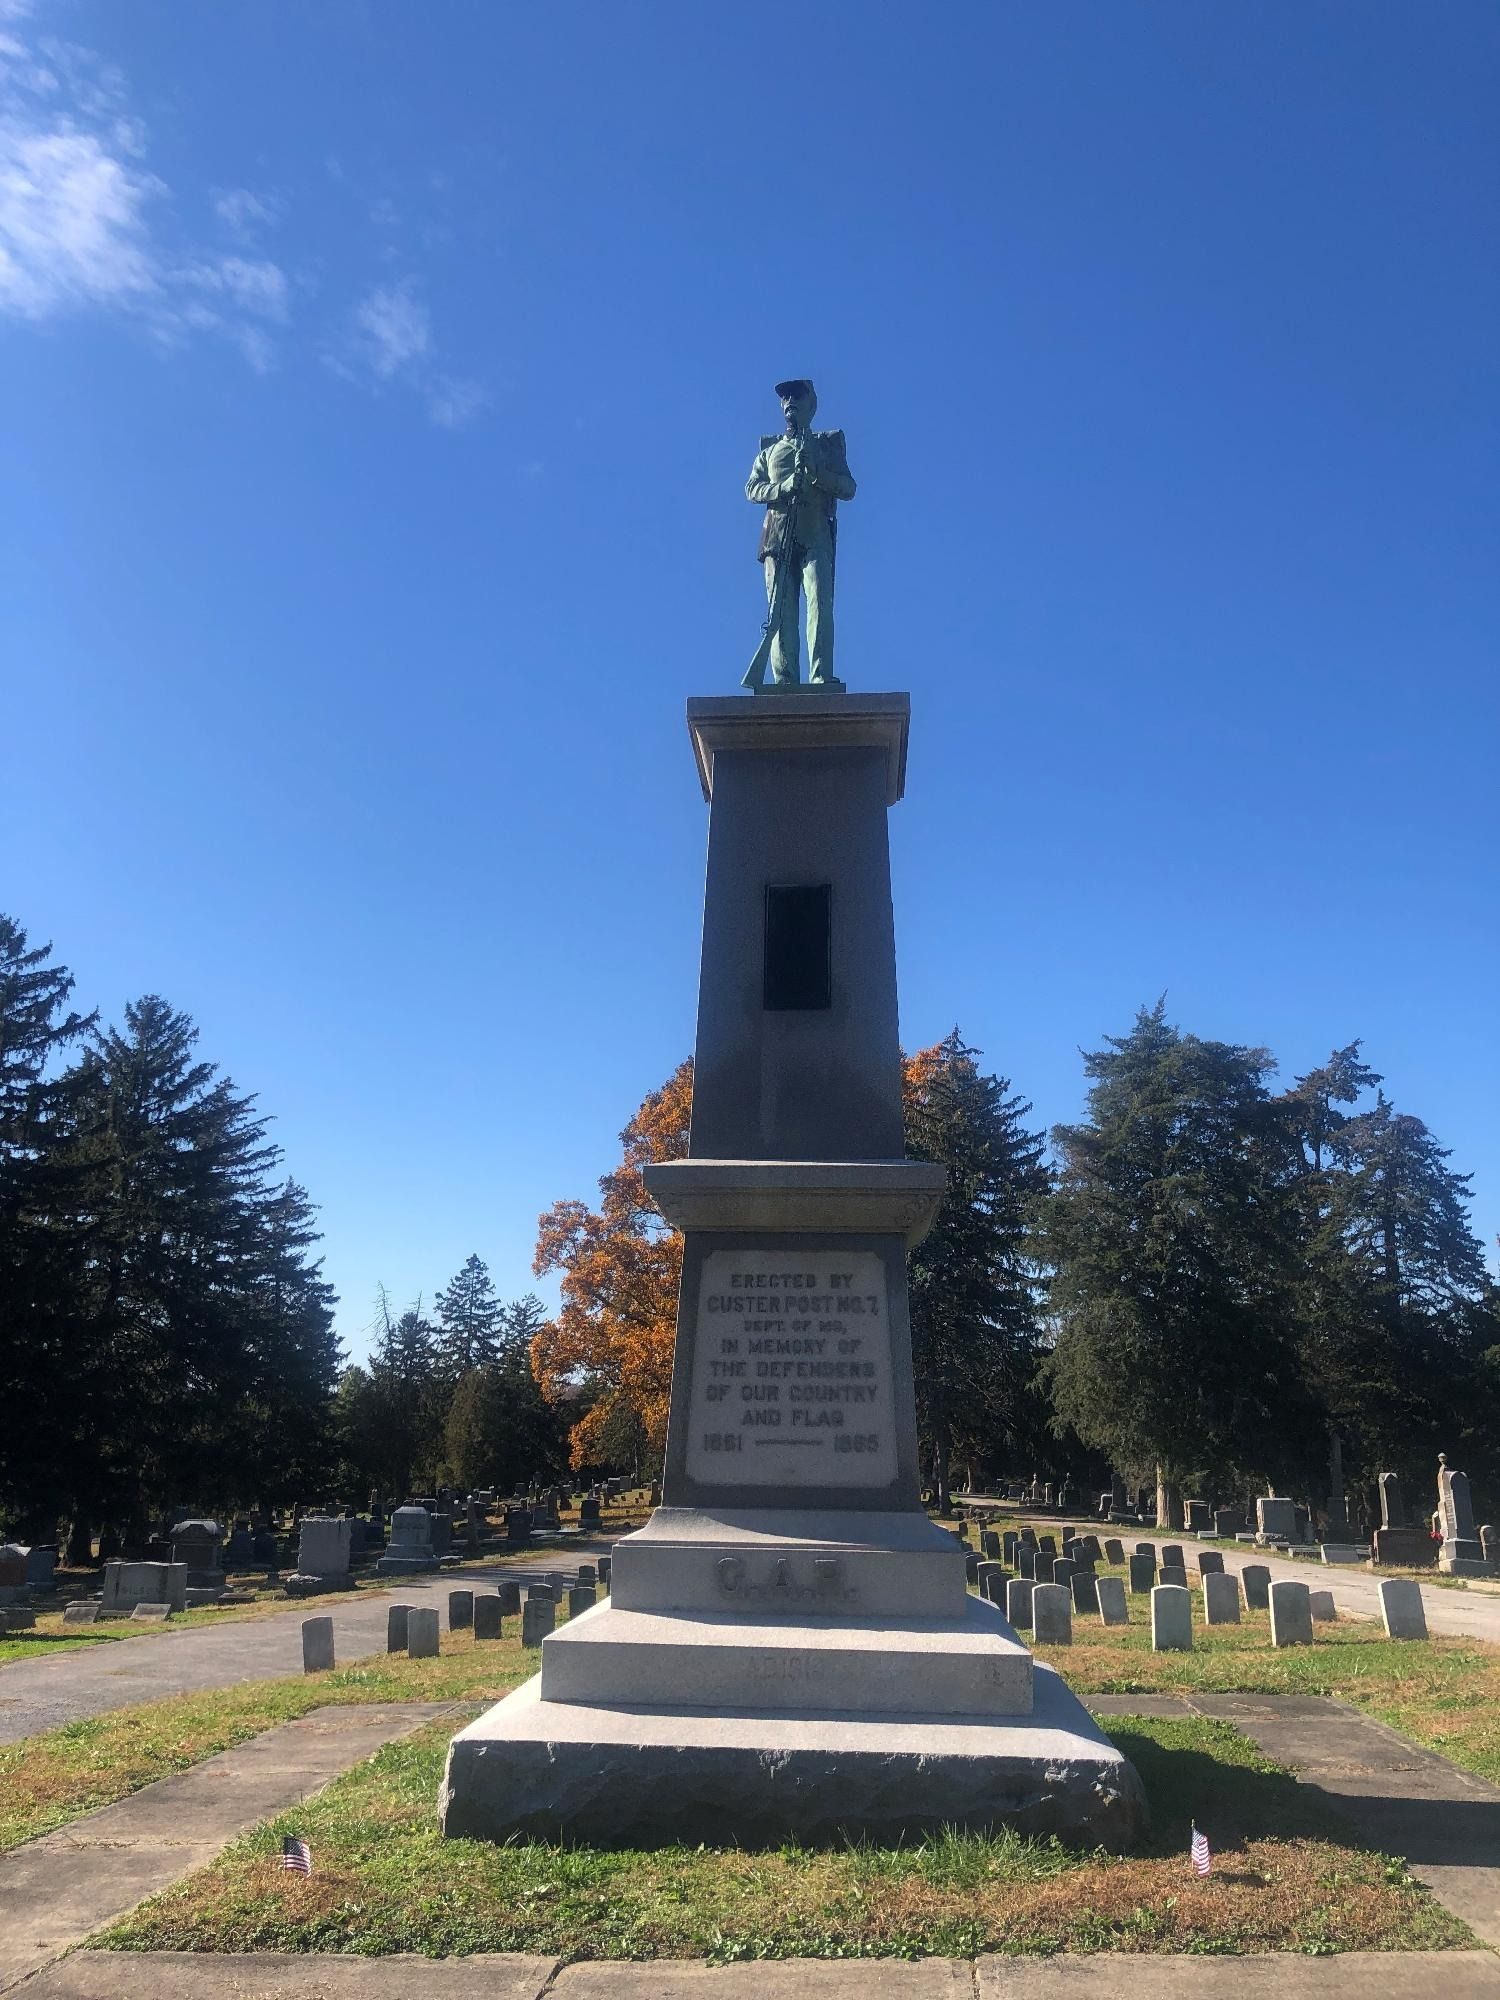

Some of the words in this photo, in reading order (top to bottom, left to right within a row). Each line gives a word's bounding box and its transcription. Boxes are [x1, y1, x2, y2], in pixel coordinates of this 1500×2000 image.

[731, 1274, 816, 1288] ERECTED
[830, 1274, 853, 1288] BY
[707, 1296, 780, 1313] CUSTER
[785, 1296, 833, 1313] POST
[792, 1320, 811, 1332] OF
[722, 1339, 738, 1353] IN
[749, 1339, 826, 1354] MEMORY
[838, 1339, 862, 1353] OF
[710, 1361, 746, 1377] THE
[757, 1361, 875, 1378] DEFENDERS
[706, 1385, 730, 1401] OF
[742, 1385, 779, 1401] OUR
[790, 1385, 877, 1402] COUNTRY
[742, 1409, 781, 1426] AND
[792, 1409, 844, 1426] FLAG
[704, 1434, 742, 1451] 1861
[834, 1434, 878, 1452] 1865
